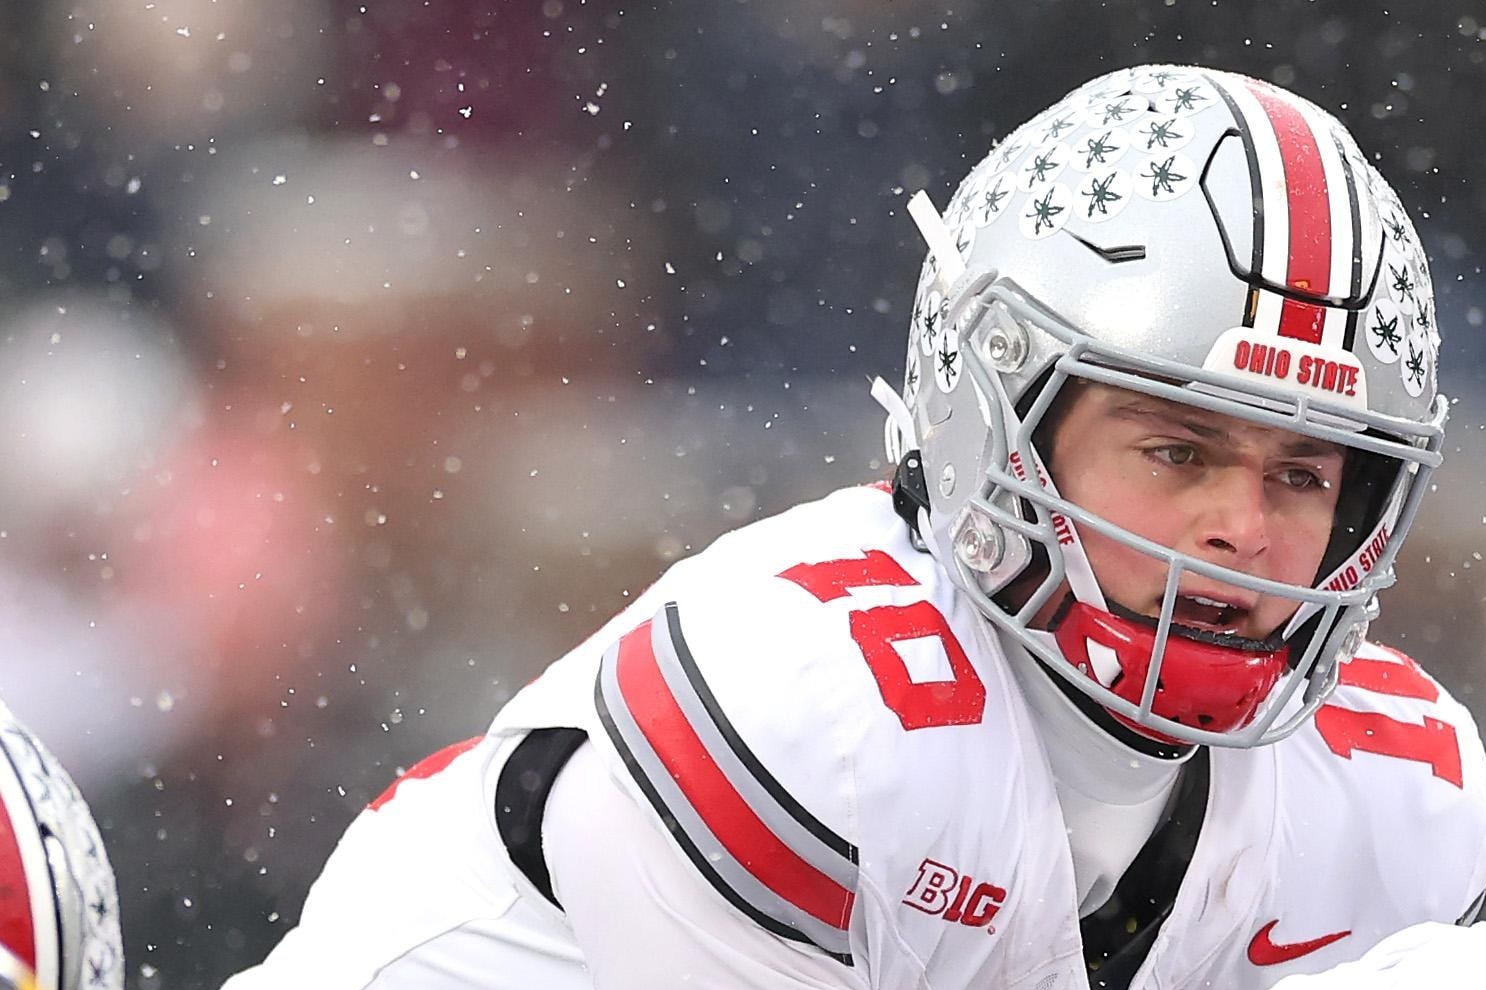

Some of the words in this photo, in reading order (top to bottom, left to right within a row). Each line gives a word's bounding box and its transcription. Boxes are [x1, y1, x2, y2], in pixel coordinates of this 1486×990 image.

[1234, 340, 1291, 379] OHIO
[1297, 355, 1360, 397] STATE
[1323, 565, 1358, 592] HIO
[1358, 522, 1391, 572] STATE
[775, 547, 986, 732] 10
